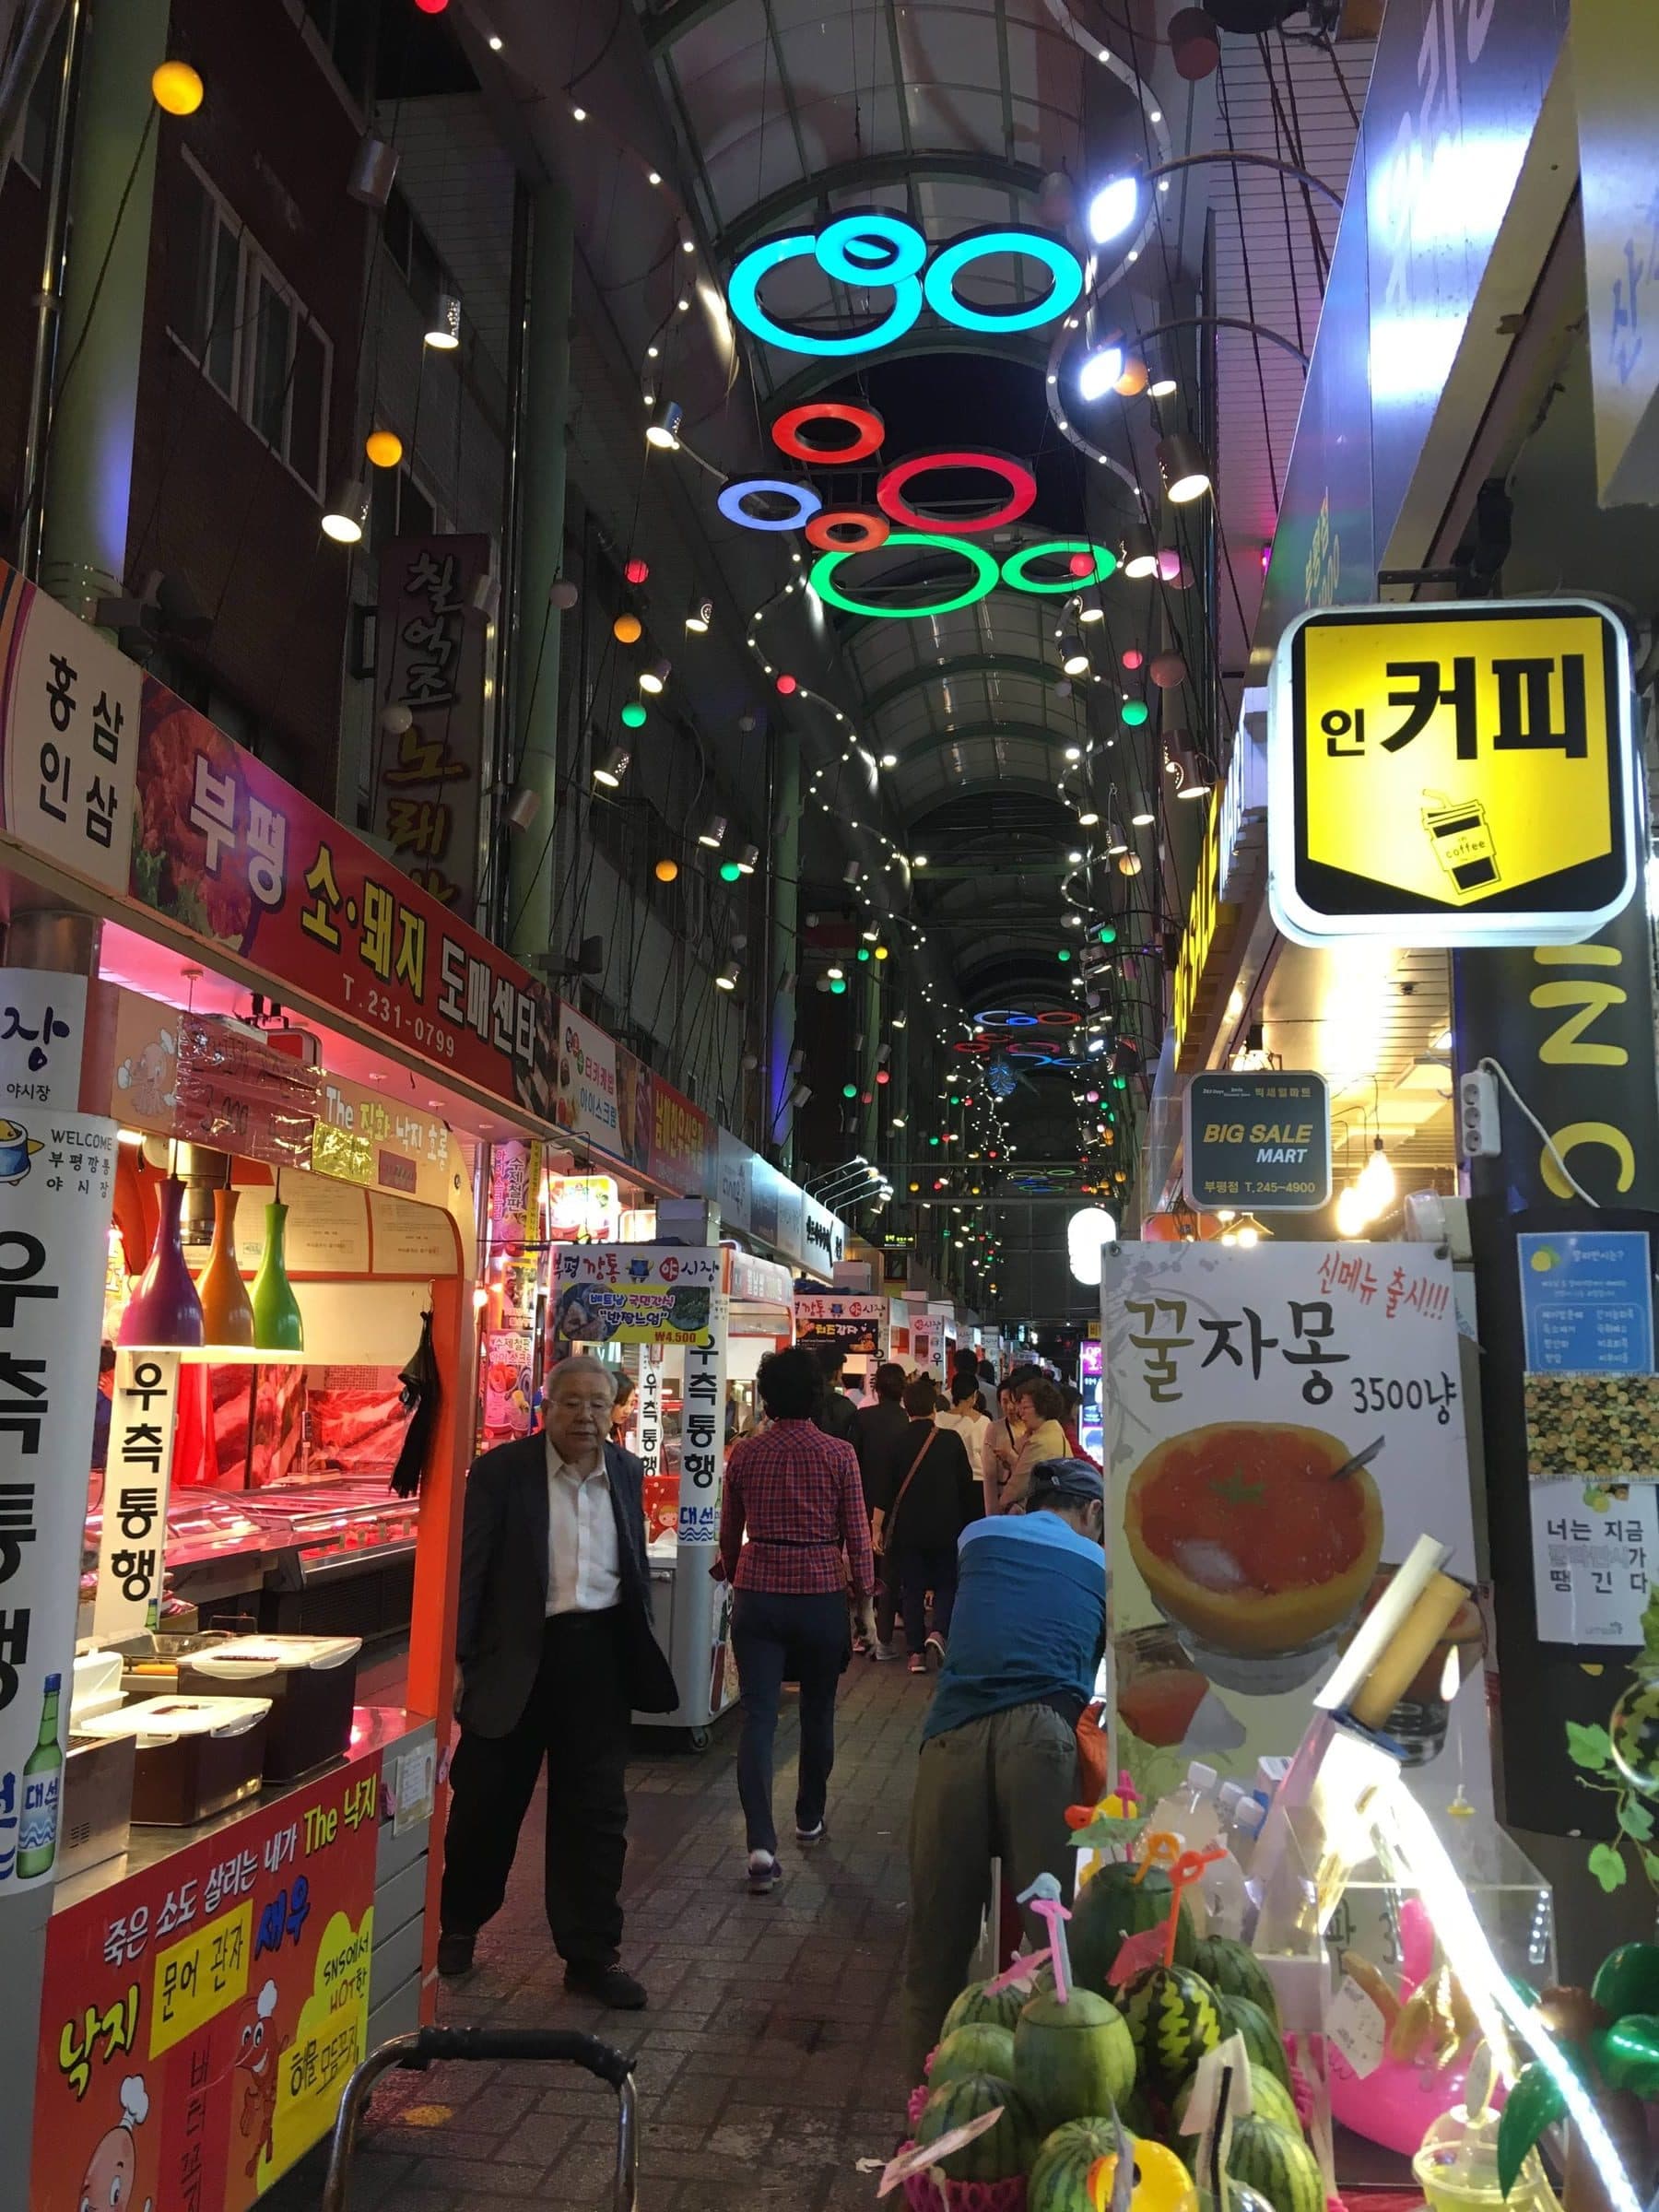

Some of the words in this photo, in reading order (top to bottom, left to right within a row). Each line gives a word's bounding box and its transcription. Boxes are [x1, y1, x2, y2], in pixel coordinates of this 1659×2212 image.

[189, 756, 287, 907] 부평
[1445, 841, 1487, 858] coffee
[6, 1084, 51, 1102] 야시장
[580, 1088, 617, 1129] 아이스크림
[51, 1129, 112, 1151] WELCOME
[326, 1086, 354, 1130] The
[396, 1114, 424, 1151] 낙지
[1203, 1124, 1245, 1144] BIG
[1249, 1124, 1313, 1144] SALE
[1256, 1148, 1308, 1163] MART
[507, 1157, 525, 1214] 수제철판
[1204, 1181, 1239, 1194] 부평점
[582, 1253, 620, 1283] 깡통
[1318, 1252, 1379, 1305] 신메뉴
[1386, 1266, 1451, 1321] 출시!!!
[591, 1293, 625, 1307] 베트남
[629, 1294, 675, 1309] 국민간식
[1124, 1299, 1350, 1406] 꿀자몽
[1350, 1371, 1457, 1425] 3500냥
[641, 1373, 657, 1477] 우측통행
[111, 1361, 167, 1601] 우측통행
[679, 1507, 714, 1524] 대선
[1547, 1519, 1592, 1541] 너는
[1605, 1520, 1643, 1542] 지금
[104, 1905, 149, 1967] 죽은
[155, 1879, 198, 1938] 소도
[204, 1849, 258, 1914] 살리는
[265, 1823, 297, 1873] 내가
[304, 1805, 337, 1857] The
[344, 1773, 377, 1830] 낙지
[163, 1948, 199, 2023] 문어
[58, 1983, 140, 2101] 낙지
